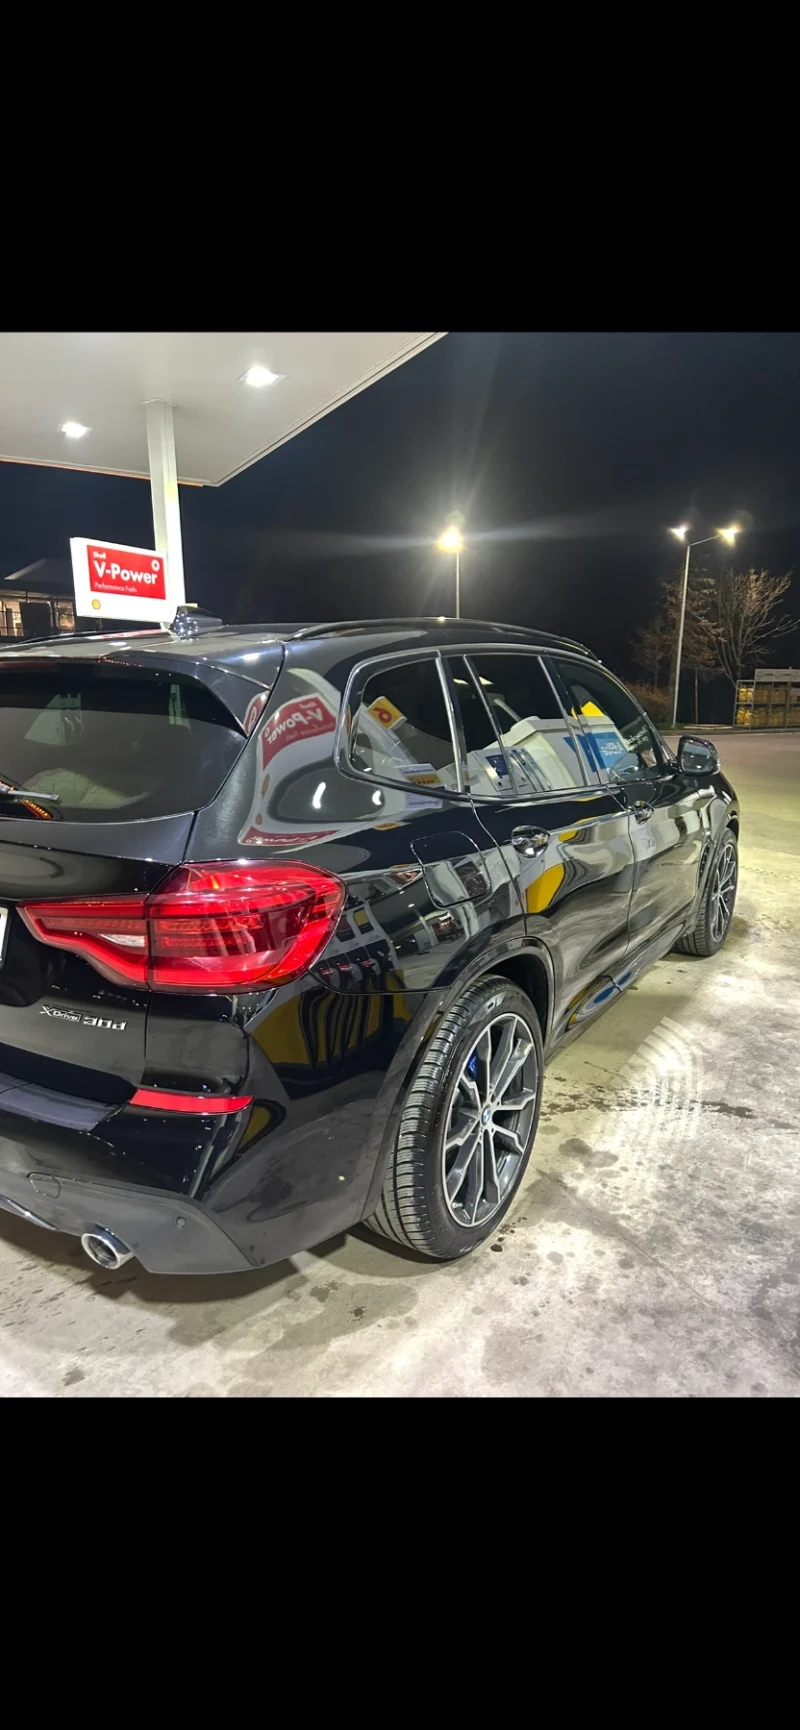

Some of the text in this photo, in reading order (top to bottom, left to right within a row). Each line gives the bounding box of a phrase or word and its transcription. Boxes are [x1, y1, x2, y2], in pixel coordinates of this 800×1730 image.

[92, 551, 107, 559] Shell
[93, 560, 158, 584] V-Power
[94, 581, 125, 591] Performance
[83, 1016, 127, 1031] 30d
